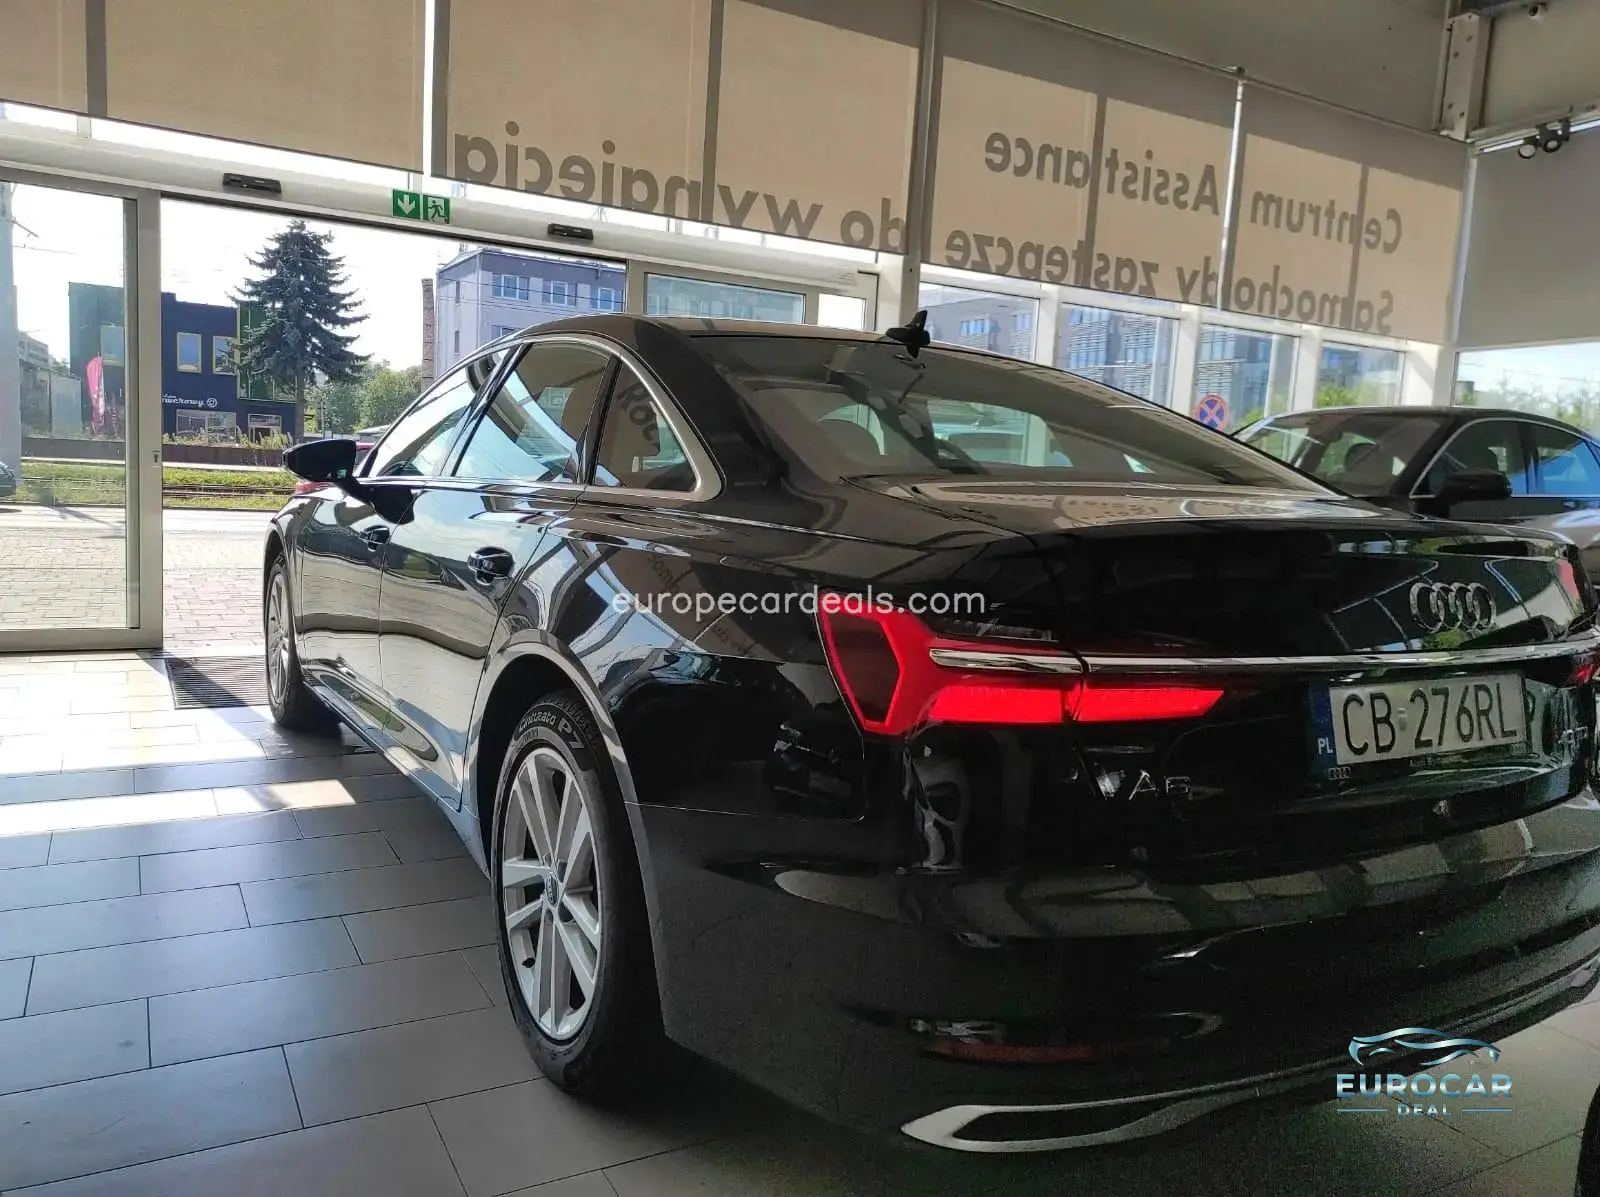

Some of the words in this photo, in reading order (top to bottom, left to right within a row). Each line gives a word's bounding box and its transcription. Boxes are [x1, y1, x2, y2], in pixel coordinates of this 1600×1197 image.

[557, 717, 584, 749] P7
[1342, 692, 1397, 756] CB
[1409, 682, 1518, 749] 276RL
[1317, 737, 1334, 755] PL
